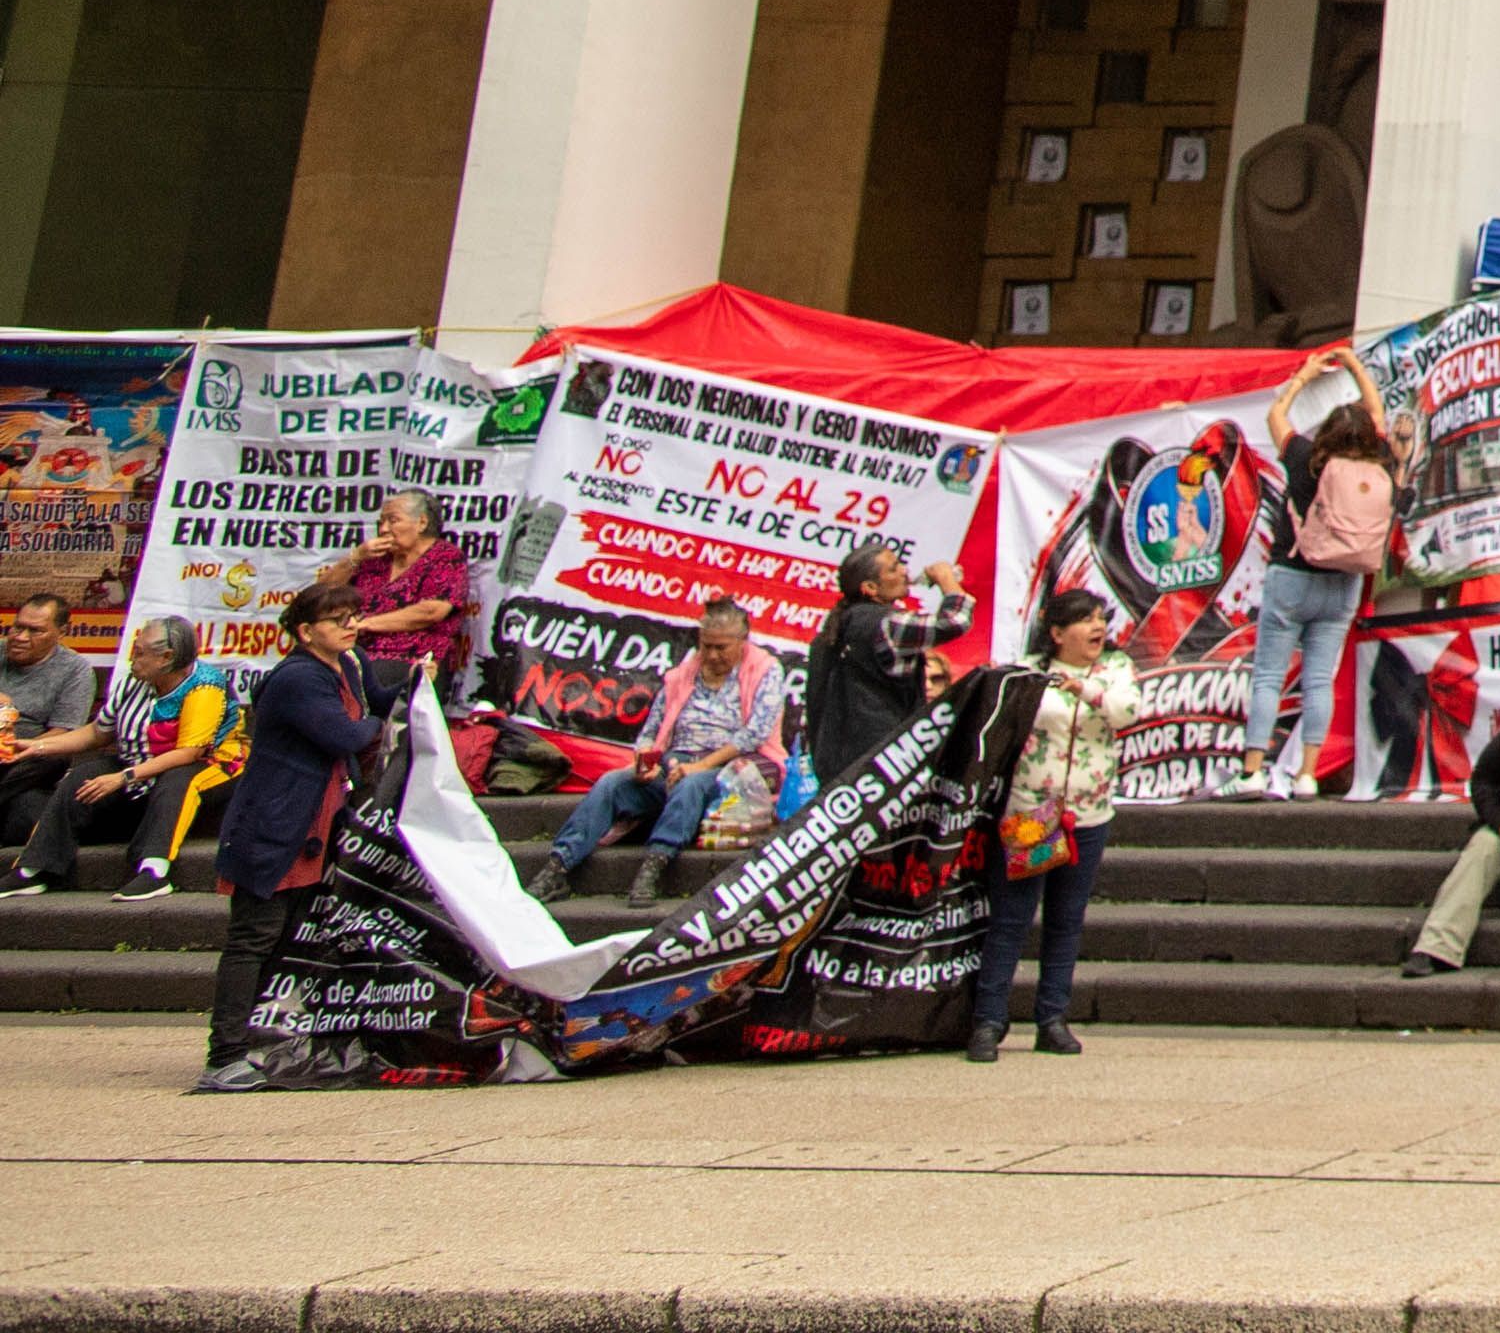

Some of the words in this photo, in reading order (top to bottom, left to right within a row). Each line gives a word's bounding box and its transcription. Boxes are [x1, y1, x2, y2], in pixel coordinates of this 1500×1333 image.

[186, 410, 242, 433] IMSS
[616, 366, 652, 400] CON
[657, 374, 695, 408] DOS
[698, 384, 788, 428] NEURONAS
[812, 407, 862, 443] CERO
[862, 418, 942, 460] INSUMOS
[623, 406, 692, 440] PERSONAL
[733, 429, 777, 458] SALUD
[239, 445, 328, 478] BASTA
[595, 445, 645, 476] NO
[169, 480, 235, 511] LOS
[654, 487, 717, 525] ESTE
[704, 459, 768, 497] NO
[774, 477, 822, 513] AL
[834, 491, 892, 528] 2.9
[9, 501, 65, 523] SALUD
[20, 531, 115, 553] SOLIDARIA
[220, 517, 367, 551] NUESTRA
[597, 521, 696, 561] CUANDO
[1159, 555, 1219, 588] SNTSS
[712, 770, 886, 921] Jubilad@s
[873, 701, 957, 786] IMSS
[765, 820, 880, 914] Lucha
[355, 978, 437, 1005] Aumento
[281, 1007, 360, 1036] salario
[363, 1006, 438, 1033] tabular
